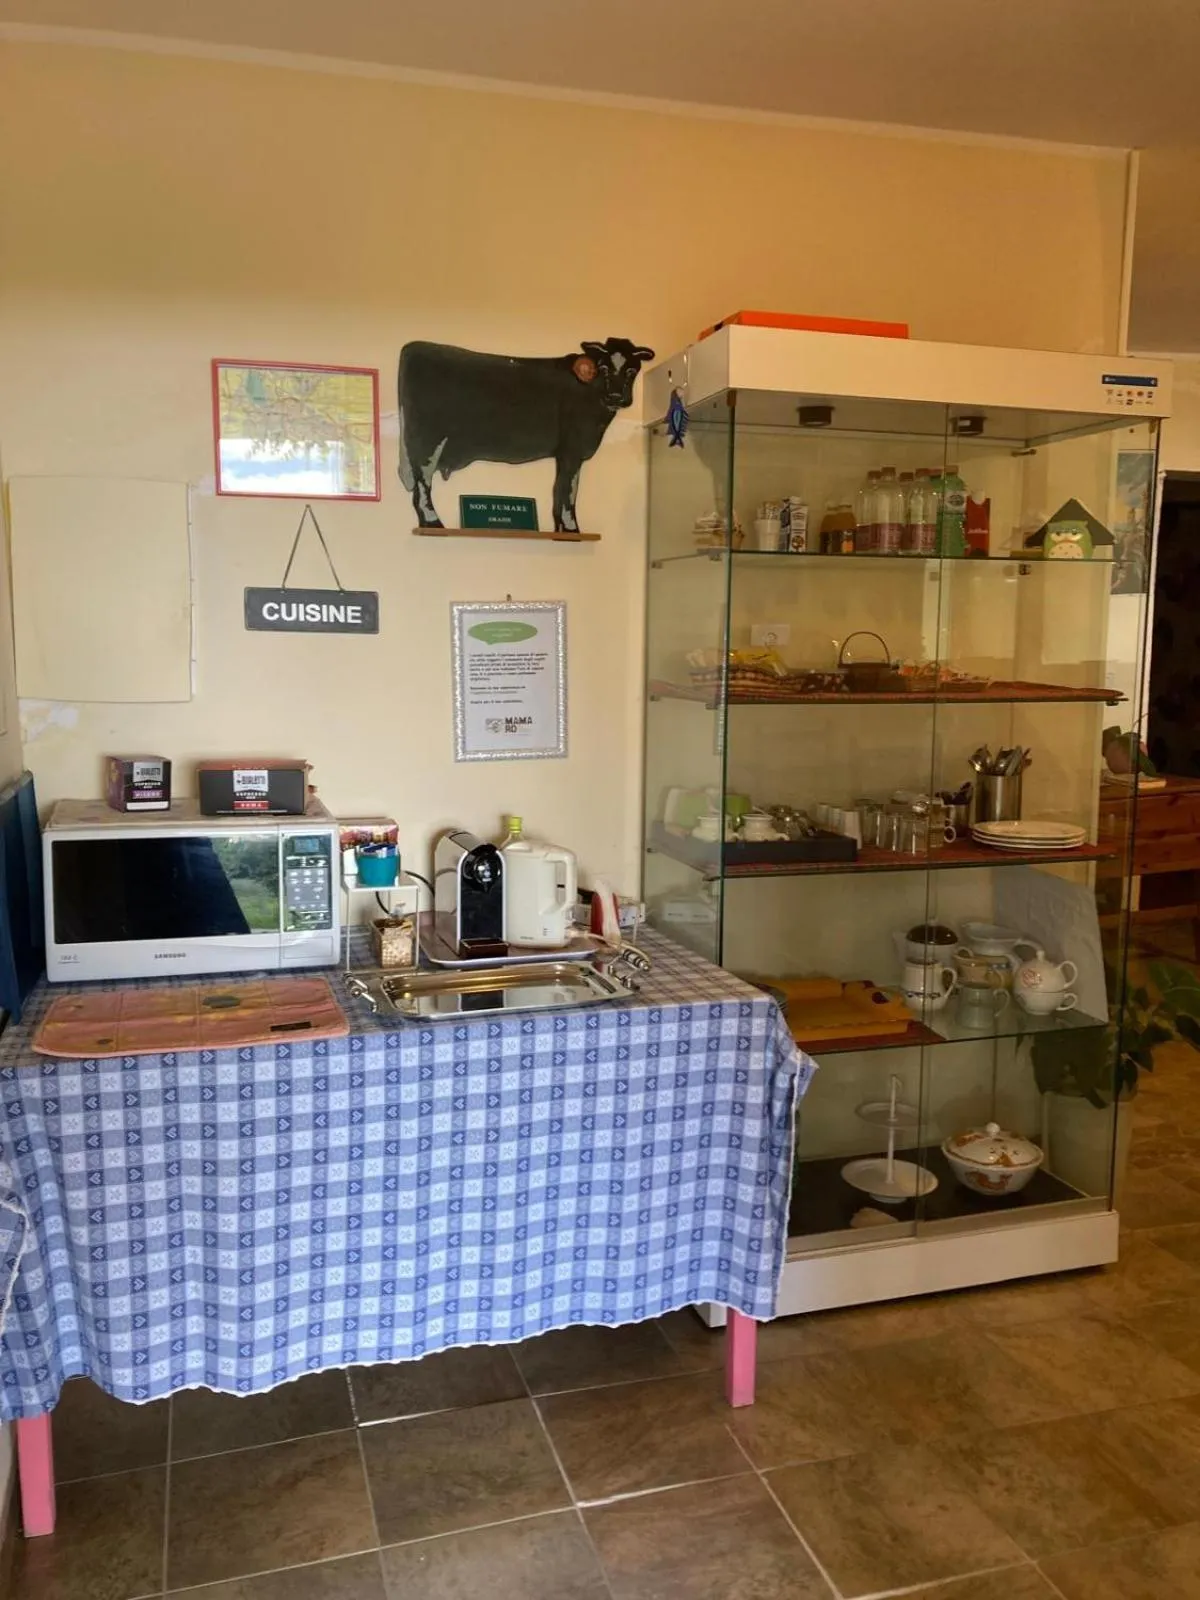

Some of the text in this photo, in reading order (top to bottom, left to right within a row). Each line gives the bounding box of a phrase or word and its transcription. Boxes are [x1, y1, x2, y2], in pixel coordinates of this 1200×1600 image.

[469, 503, 528, 513] NON FUMARE
[261, 601, 363, 624] CUISINE
[504, 716, 533, 725] MAMA
